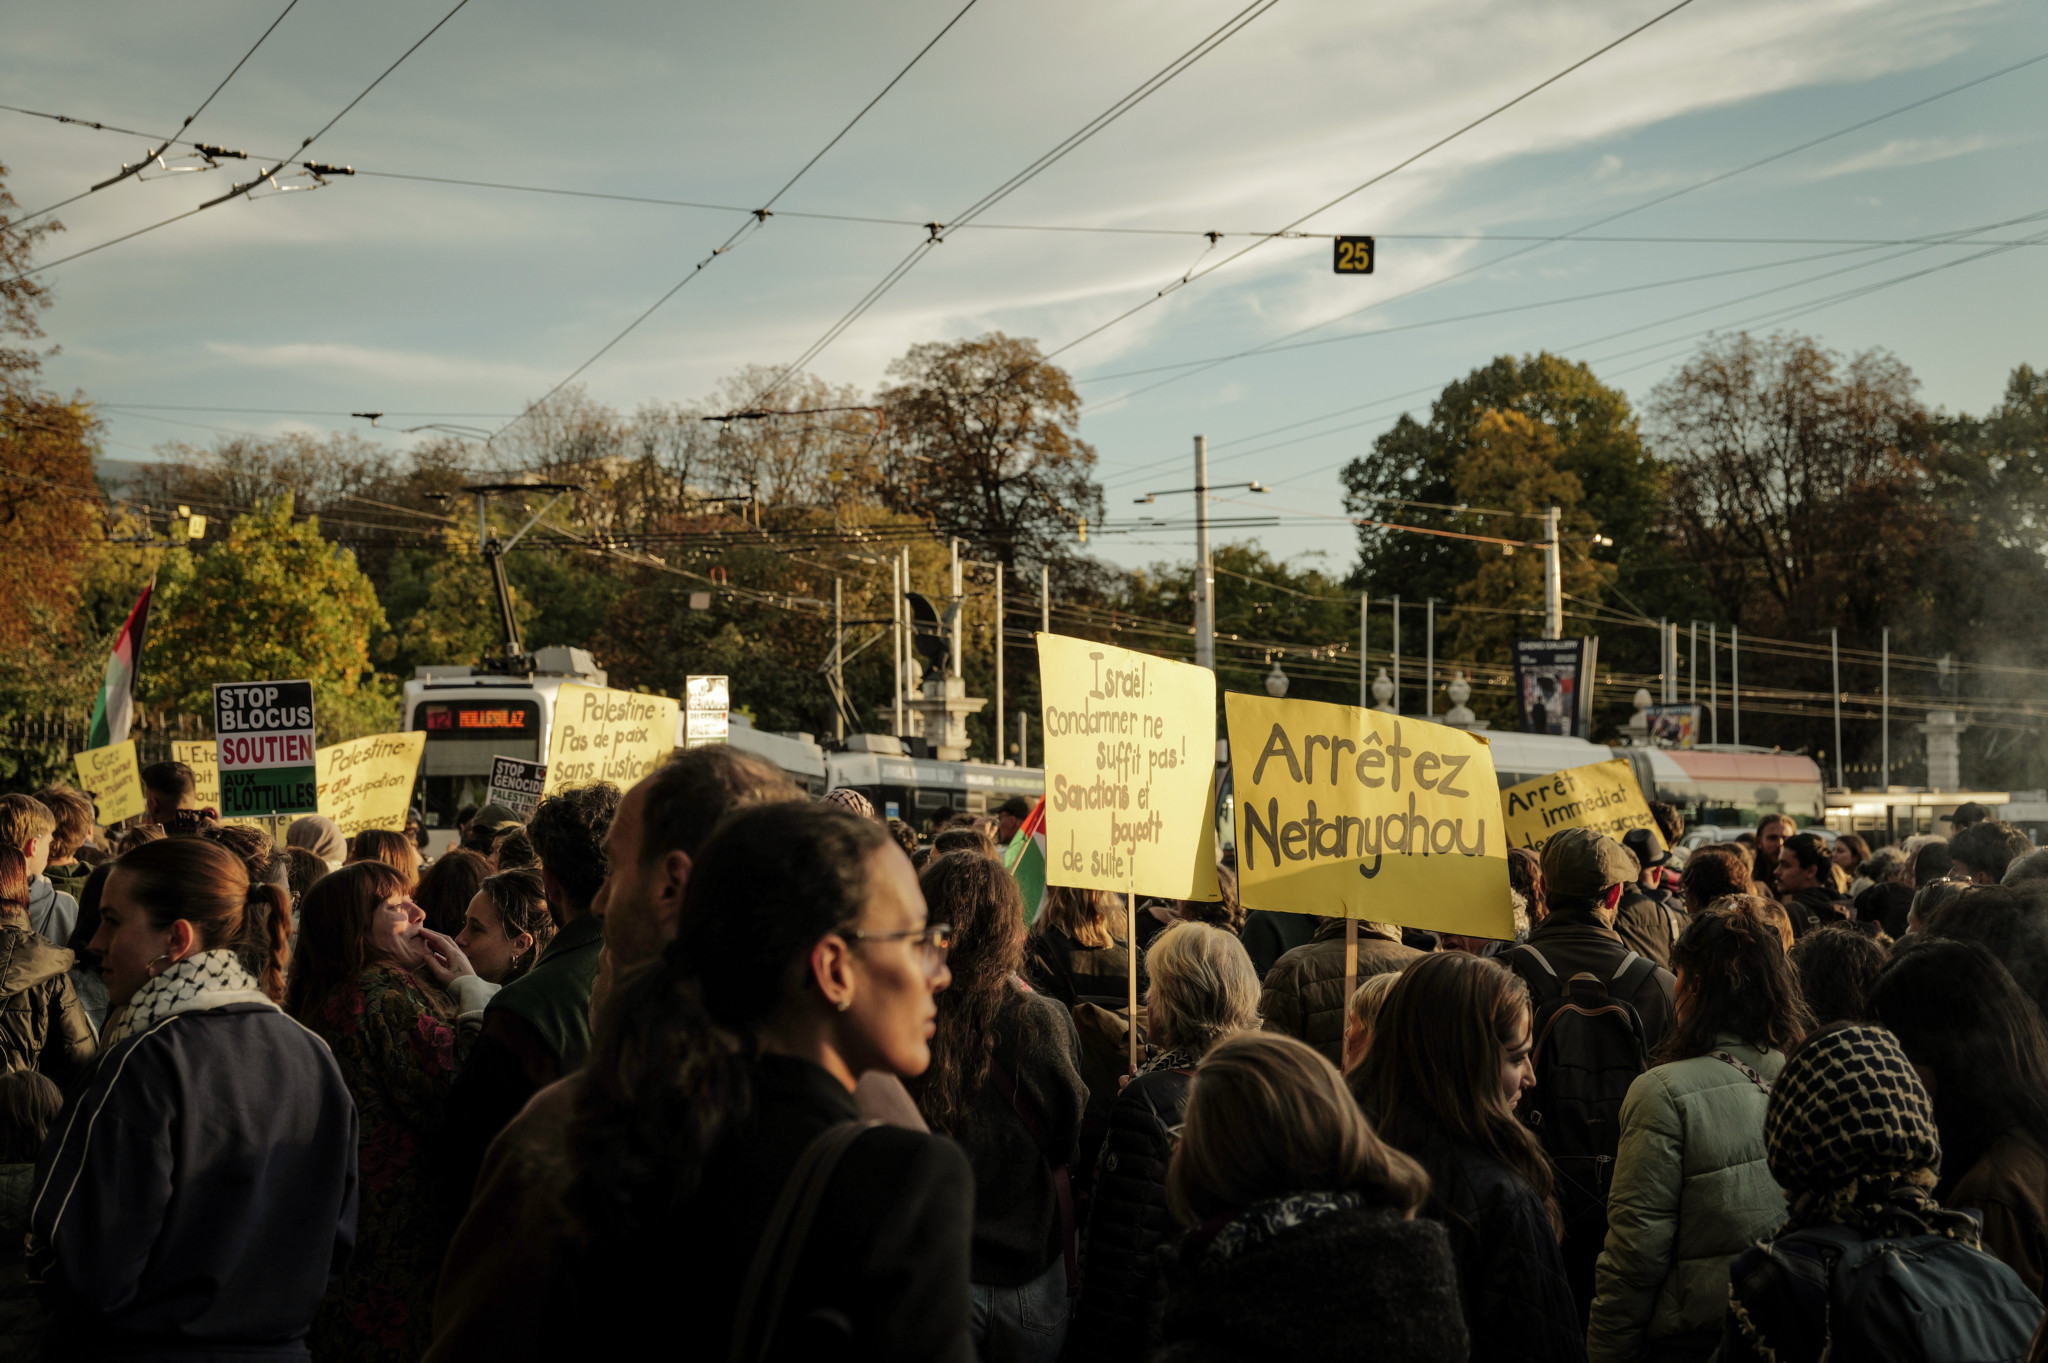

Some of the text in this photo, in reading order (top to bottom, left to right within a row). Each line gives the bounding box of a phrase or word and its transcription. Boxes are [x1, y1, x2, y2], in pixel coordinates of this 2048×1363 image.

[1338, 241, 1369, 270] 25
[220, 687, 279, 709] STOP
[221, 706, 311, 730] BLOCUS
[1046, 697, 1163, 739] Condamner ne
[223, 734, 312, 765] SOUTIEN
[560, 722, 648, 759] Pas de paix
[496, 761, 525, 777] STOP
[554, 761, 595, 781] sans
[1096, 741, 1141, 783] suffit
[1253, 720, 1471, 798] Arrêtez
[195, 769, 212, 784] oit
[224, 773, 256, 786] AUX
[331, 774, 352, 794] ans
[1053, 773, 1129, 812] Sanctions
[1138, 780, 1149, 810] et
[1508, 770, 1575, 817] Arrêt
[224, 783, 315, 812] FLOTTILLES
[1541, 783, 1627, 827] immédiat
[1111, 810, 1163, 856] boycott
[1244, 791, 1485, 879] Netanyahou
[1063, 829, 1083, 872] de
[1091, 846, 1124, 879] suite
